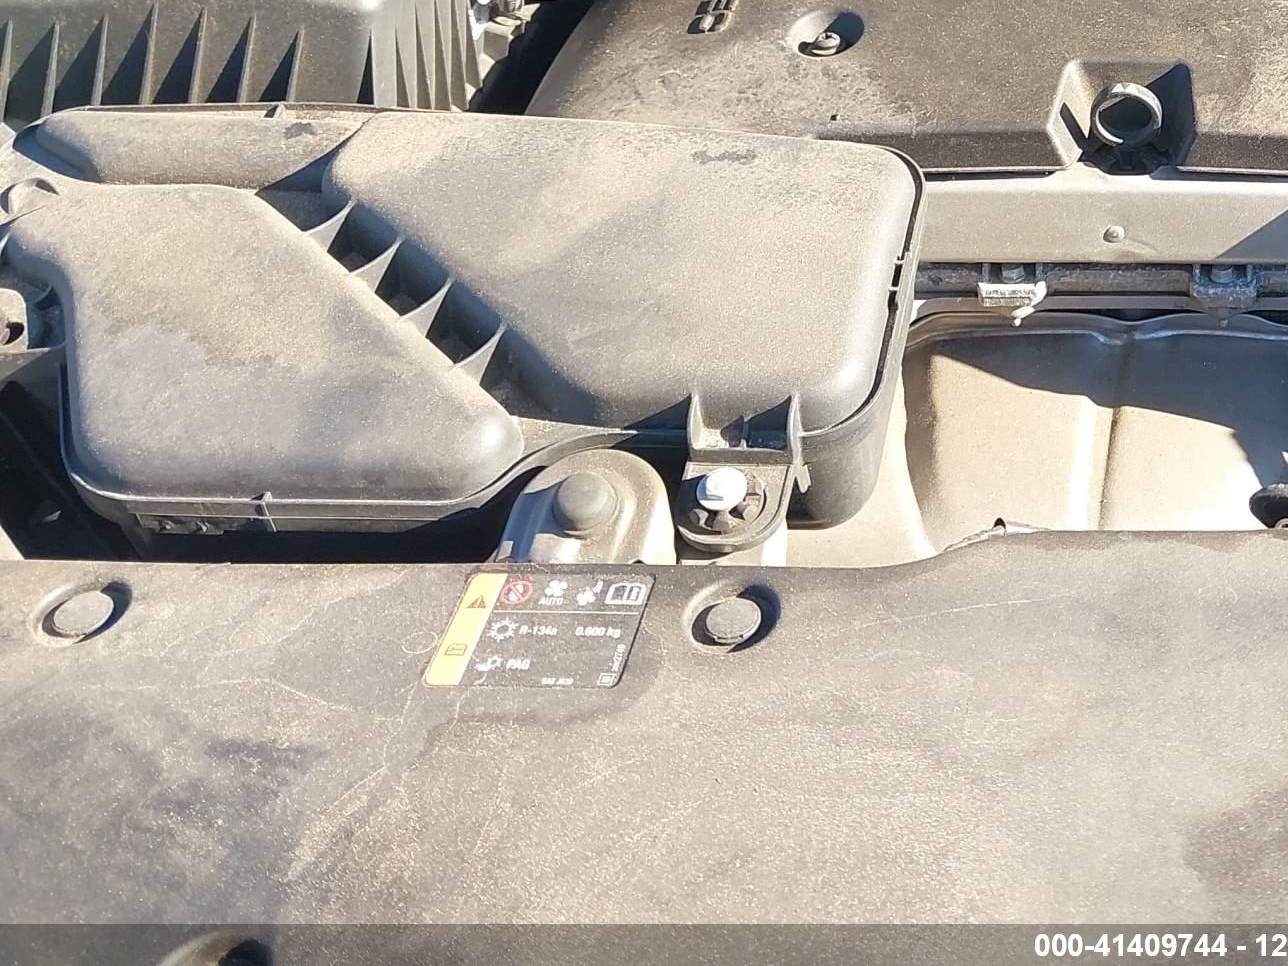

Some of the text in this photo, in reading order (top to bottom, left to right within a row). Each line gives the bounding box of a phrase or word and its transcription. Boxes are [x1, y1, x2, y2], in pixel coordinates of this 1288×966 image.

[538, 596, 564, 606] AUTO
[518, 625, 558, 636] R-134a
[605, 626, 622, 639] kg
[506, 658, 531, 671] PAG
